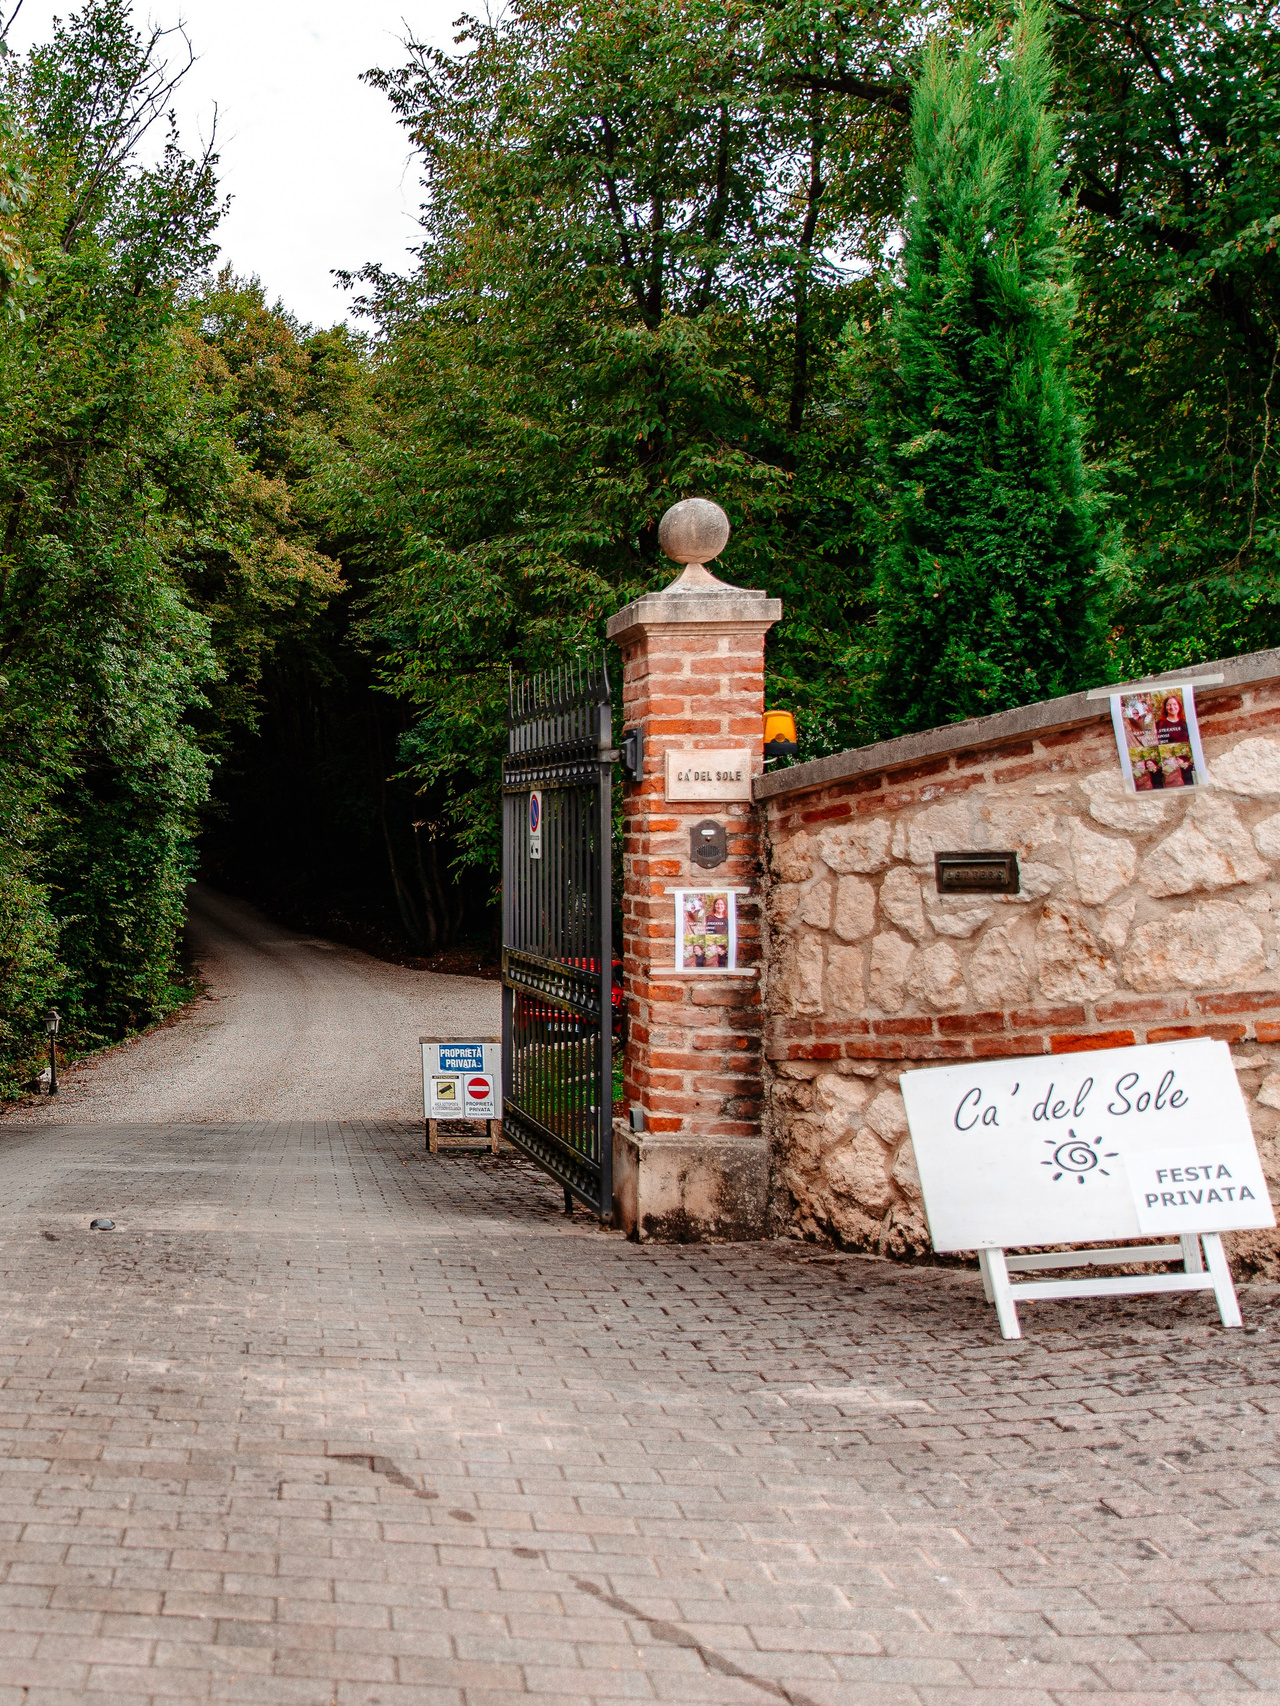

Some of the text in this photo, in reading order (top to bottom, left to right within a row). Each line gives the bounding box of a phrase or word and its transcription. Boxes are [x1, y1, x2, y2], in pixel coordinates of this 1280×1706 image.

[677, 768, 741, 781] CA' DEL SOLE
[947, 869, 1003, 880] LETTERS
[440, 1046, 482, 1058] PROPRIETÀ
[445, 1059, 477, 1068] PRIVATA
[1032, 1077, 1093, 1121] del
[1107, 1070, 1189, 1116] Sole
[1155, 1164, 1232, 1184] FESTA
[1144, 1185, 1256, 1208] PRIVATA
